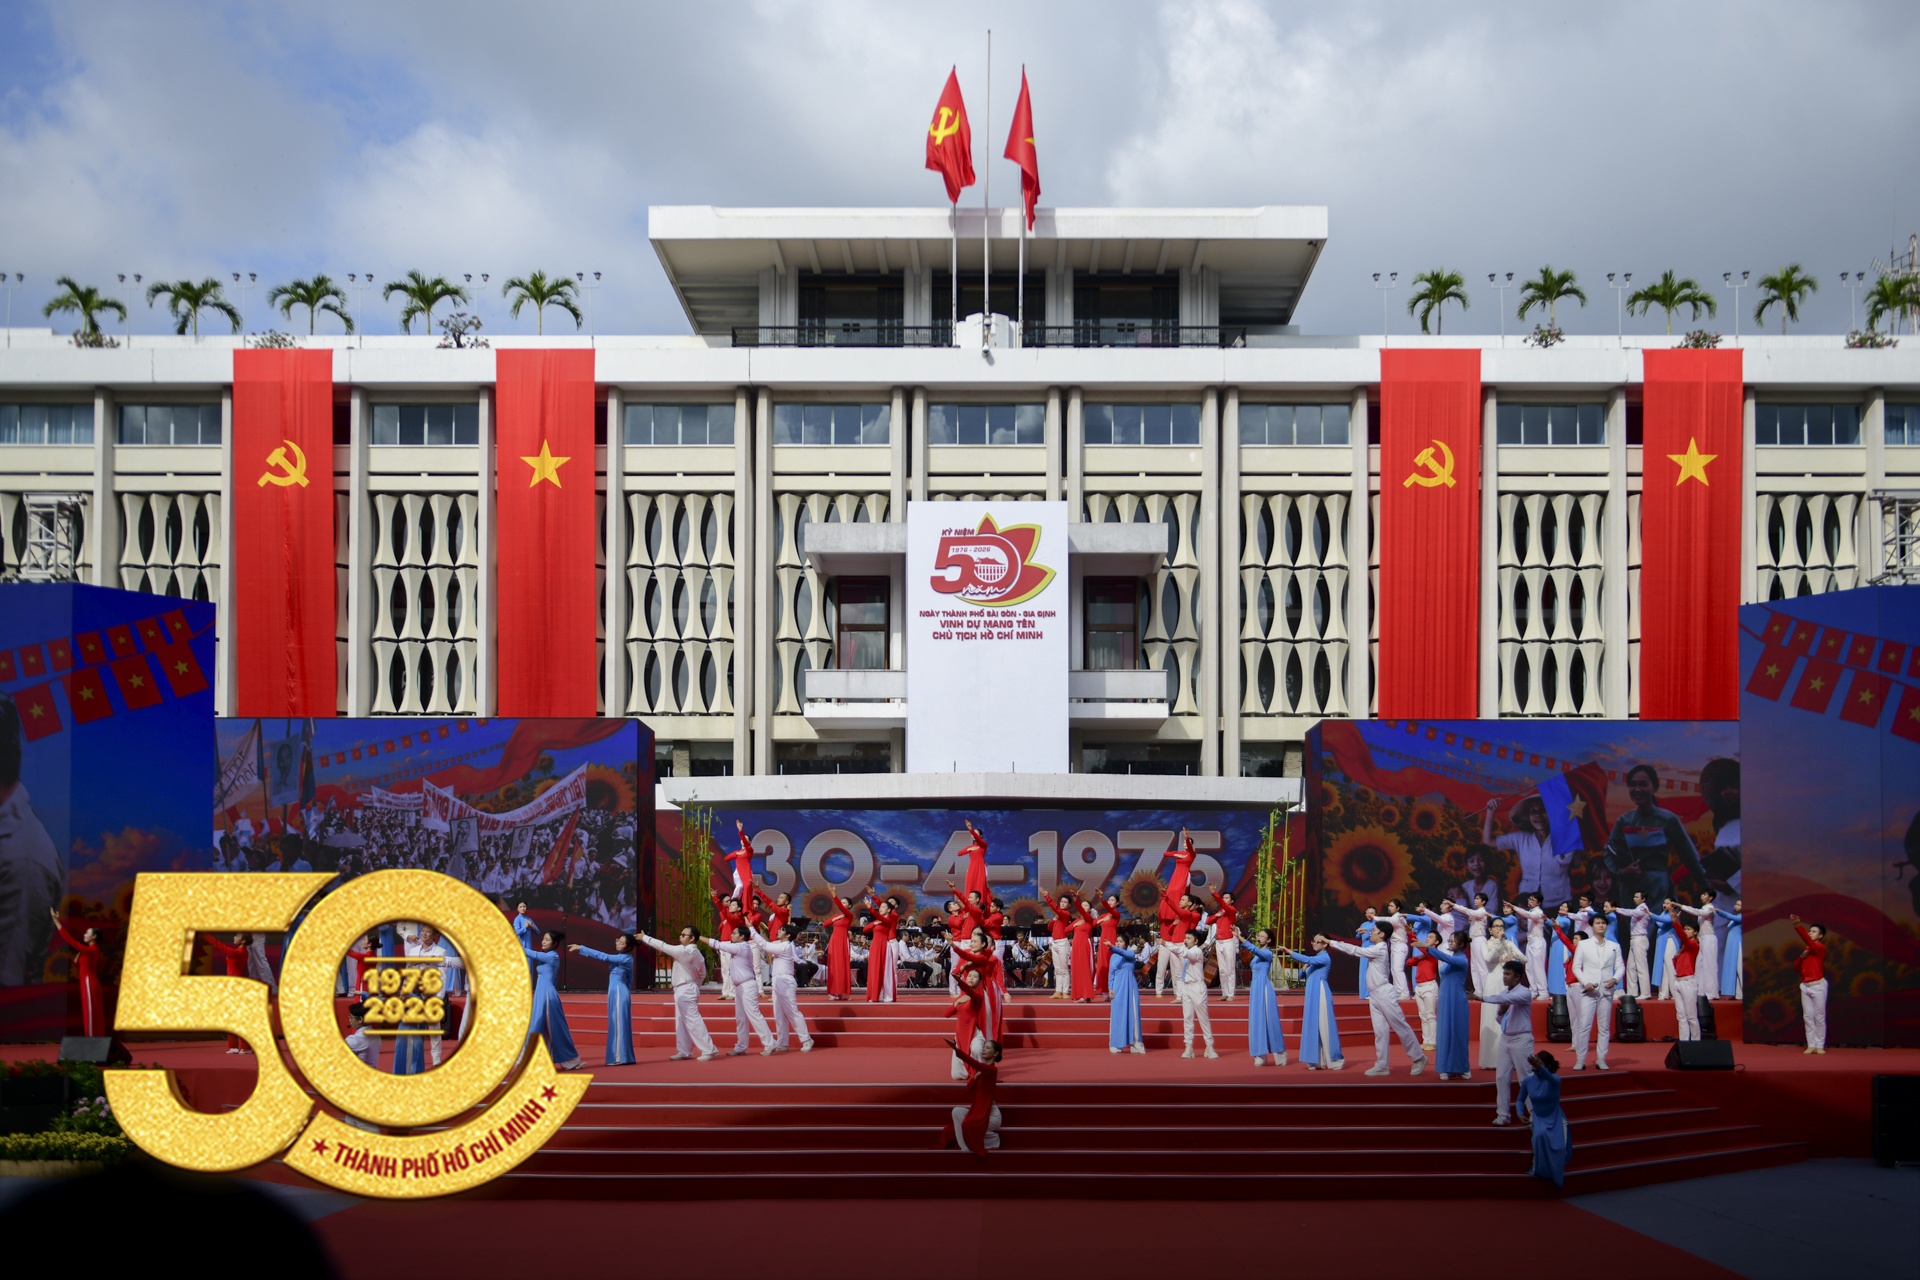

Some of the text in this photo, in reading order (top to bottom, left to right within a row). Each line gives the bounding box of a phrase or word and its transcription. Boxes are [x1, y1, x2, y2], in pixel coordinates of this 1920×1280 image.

[954, 527, 975, 537] NIỆM
[930, 536, 1019, 595] 50
[962, 585, 1006, 597] năm
[919, 609, 940, 618] NGÀY
[942, 609, 967, 618] THÀNH
[969, 608, 985, 618] PHỐ
[986, 609, 999, 618] SÀI
[1000, 609, 1017, 618] GÒN
[1022, 610, 1036, 618] GIA
[1036, 610, 1056, 619] ĐỊNH
[939, 618, 1035, 629] VINH DỰ MANG TÊN
[932, 628, 1043, 641] CHỦ TỊCH HỒ CHÍ MINH
